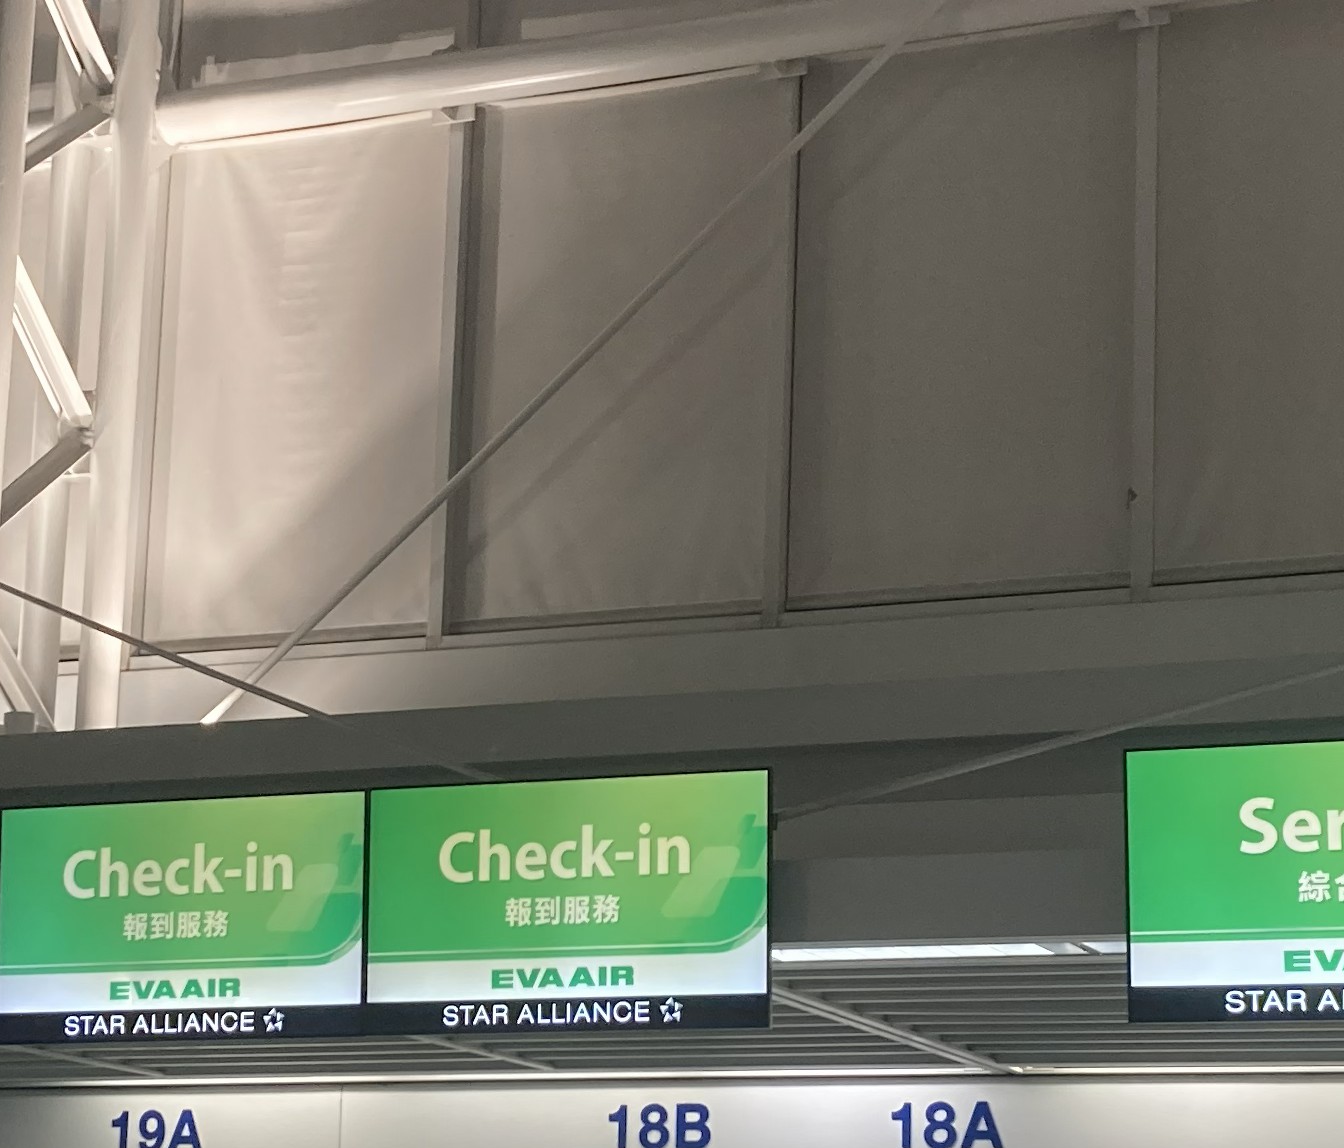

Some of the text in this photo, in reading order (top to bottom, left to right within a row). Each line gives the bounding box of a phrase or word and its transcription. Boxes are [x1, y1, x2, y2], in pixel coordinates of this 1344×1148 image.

[438, 822, 691, 883] Check-in
[63, 841, 294, 900] Check-in
[123, 910, 229, 941] 報到服務
[505, 894, 621, 927] 報到服務
[442, 1001, 650, 1026] STAR ALLIANCE
[1225, 989, 1307, 1013] STAR
[64, 1011, 255, 1036] STAR ALLIANCE
